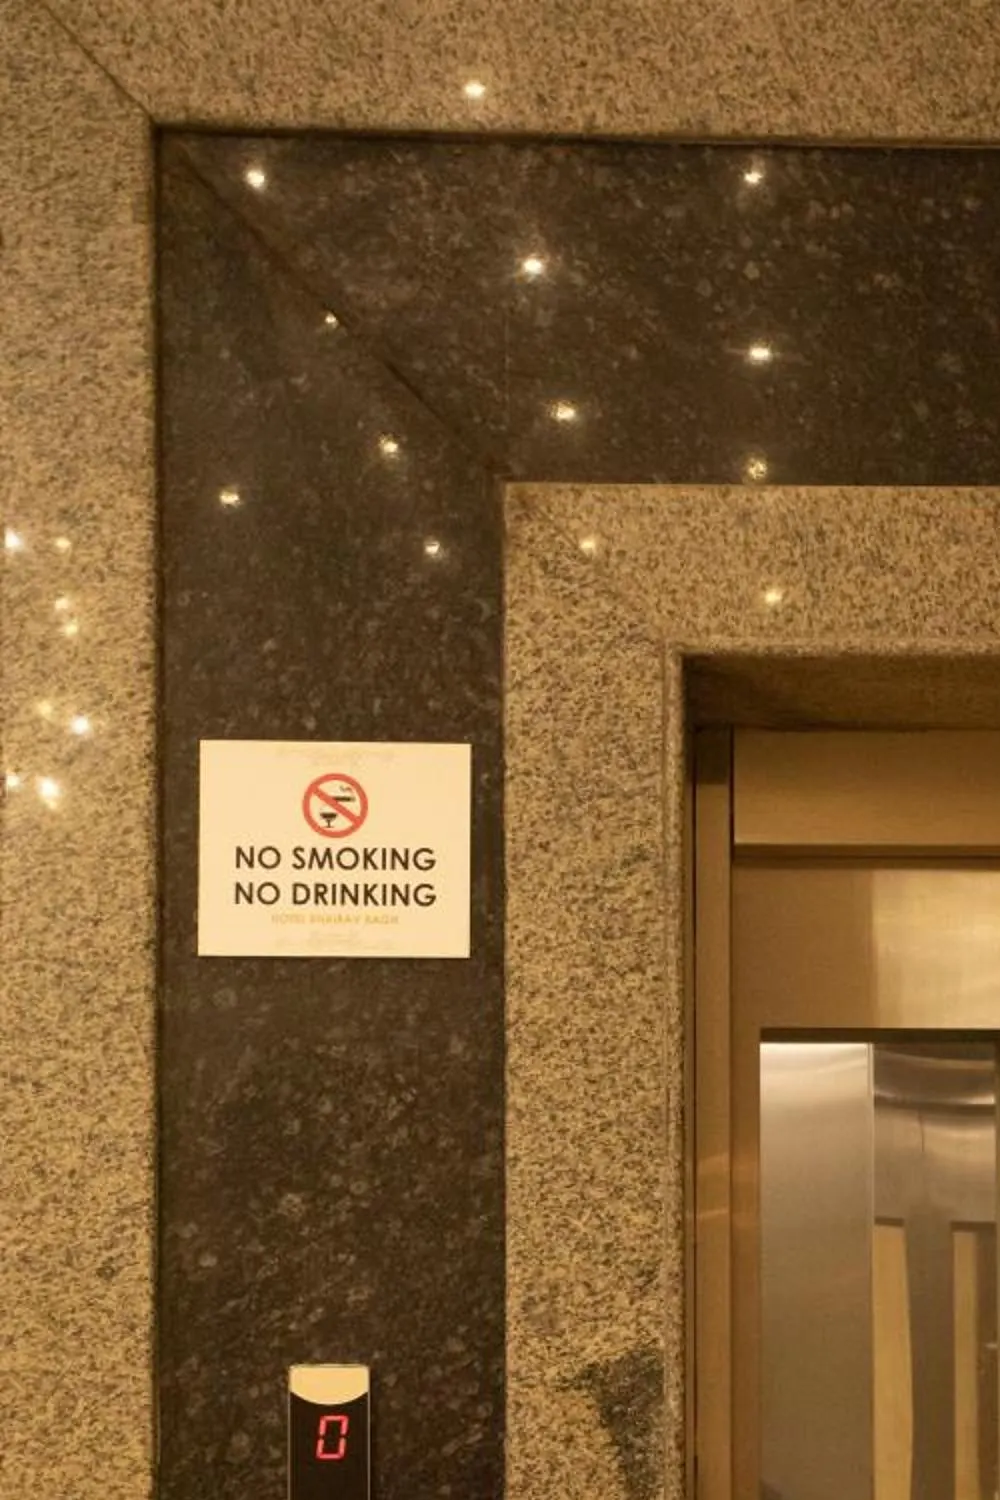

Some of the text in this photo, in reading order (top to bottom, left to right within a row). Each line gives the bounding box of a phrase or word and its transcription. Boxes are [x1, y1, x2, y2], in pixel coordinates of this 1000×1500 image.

[235, 846, 437, 871] NO SMOKING
[234, 882, 437, 907] NO DRINKING
[316, 1414, 349, 1459] 0
